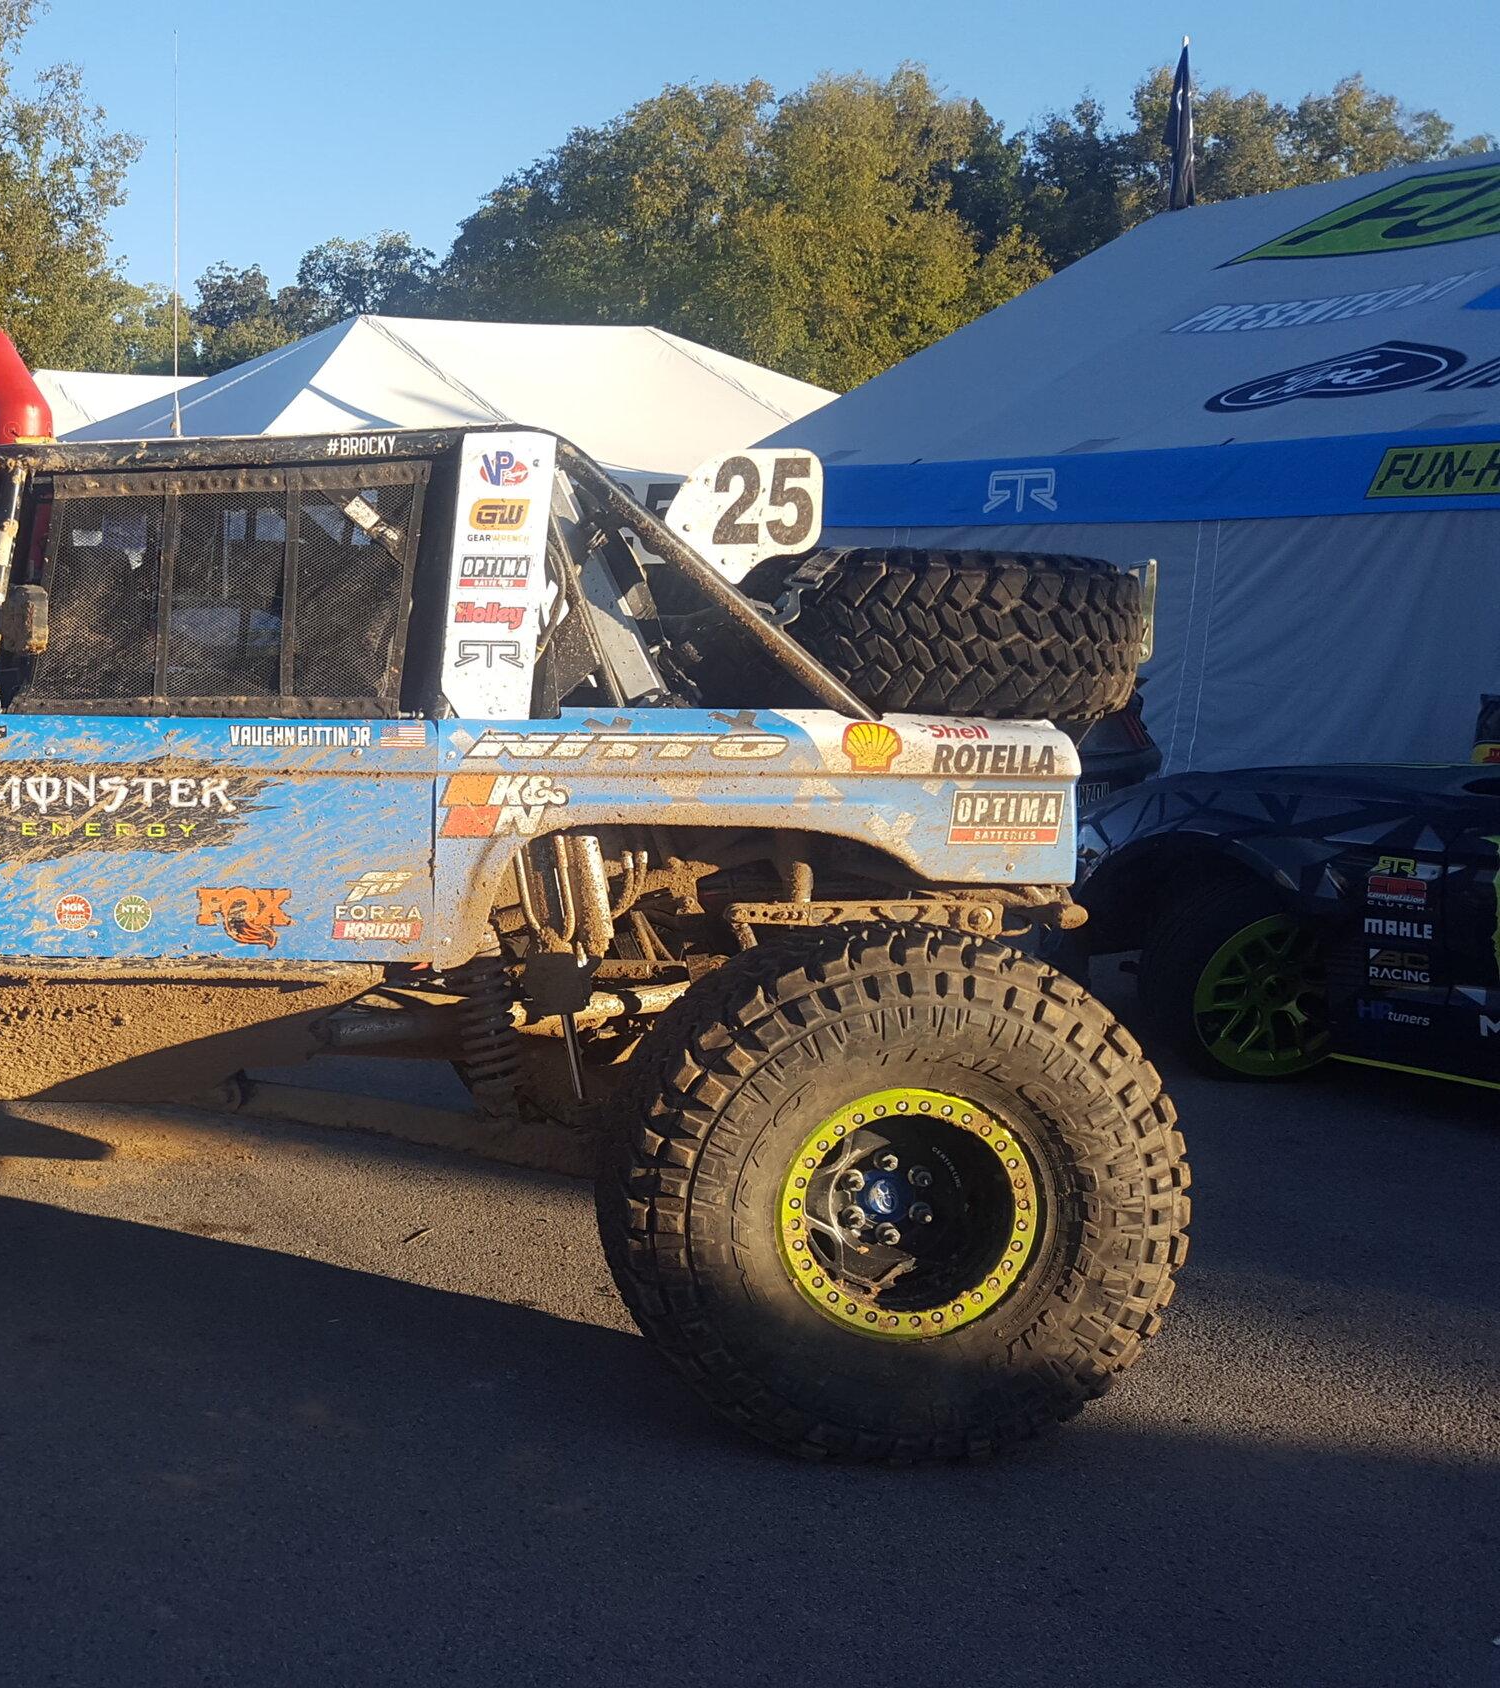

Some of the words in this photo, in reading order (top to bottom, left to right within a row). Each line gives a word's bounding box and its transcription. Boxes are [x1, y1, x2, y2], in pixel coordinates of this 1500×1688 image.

[1279, 170, 1500, 247] FU
[327, 436, 396, 456] #BROCKY
[482, 451, 515, 486] VP
[712, 456, 814, 546] 25
[476, 505, 524, 525] GW
[462, 558, 528, 576] OPTIMA
[454, 602, 527, 630] Holley
[229, 726, 295, 747] VAUGHN
[297, 726, 350, 747] GITTIN
[351, 727, 372, 747] JR
[928, 725, 989, 739] Shell
[463, 732, 790, 759] NITTO
[932, 744, 1056, 775] ROTELLA
[956, 797, 1057, 823] OPTIMA
[21, 823, 197, 837] ENERGY
[974, 830, 1037, 841] BATTERIES
[61, 903, 86, 912] NGK
[122, 904, 146, 914] NTK
[196, 887, 297, 938] FOX
[335, 905, 423, 921] FORZA
[1367, 900, 1425, 911] CLUTCH
[343, 921, 413, 938] HORIZON
[1364, 917, 1433, 940] MAHLE
[1369, 966, 1430, 983] RACING
[1388, 1011, 1430, 1026] tuners
